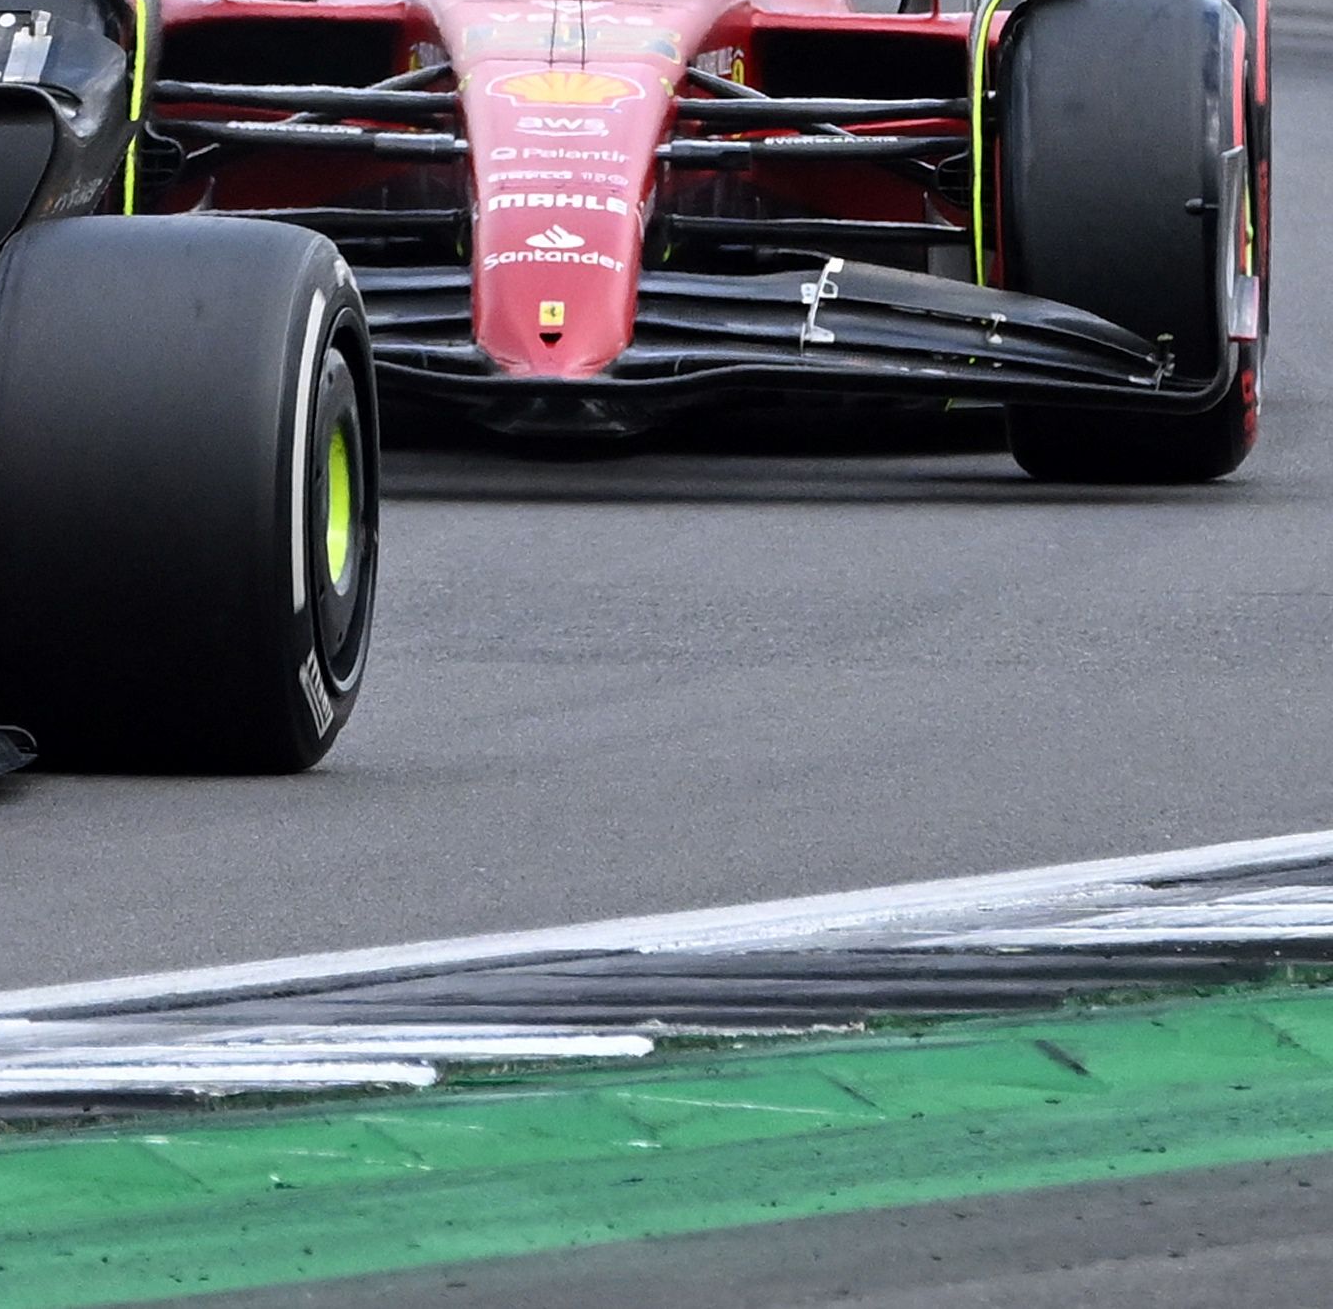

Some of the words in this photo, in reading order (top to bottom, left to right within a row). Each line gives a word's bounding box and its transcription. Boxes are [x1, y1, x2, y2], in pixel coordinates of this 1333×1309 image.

[516, 116, 608, 131] aws
[522, 147, 631, 164] Palantir
[487, 193, 629, 217] MAHLE
[483, 249, 625, 273] Santander
